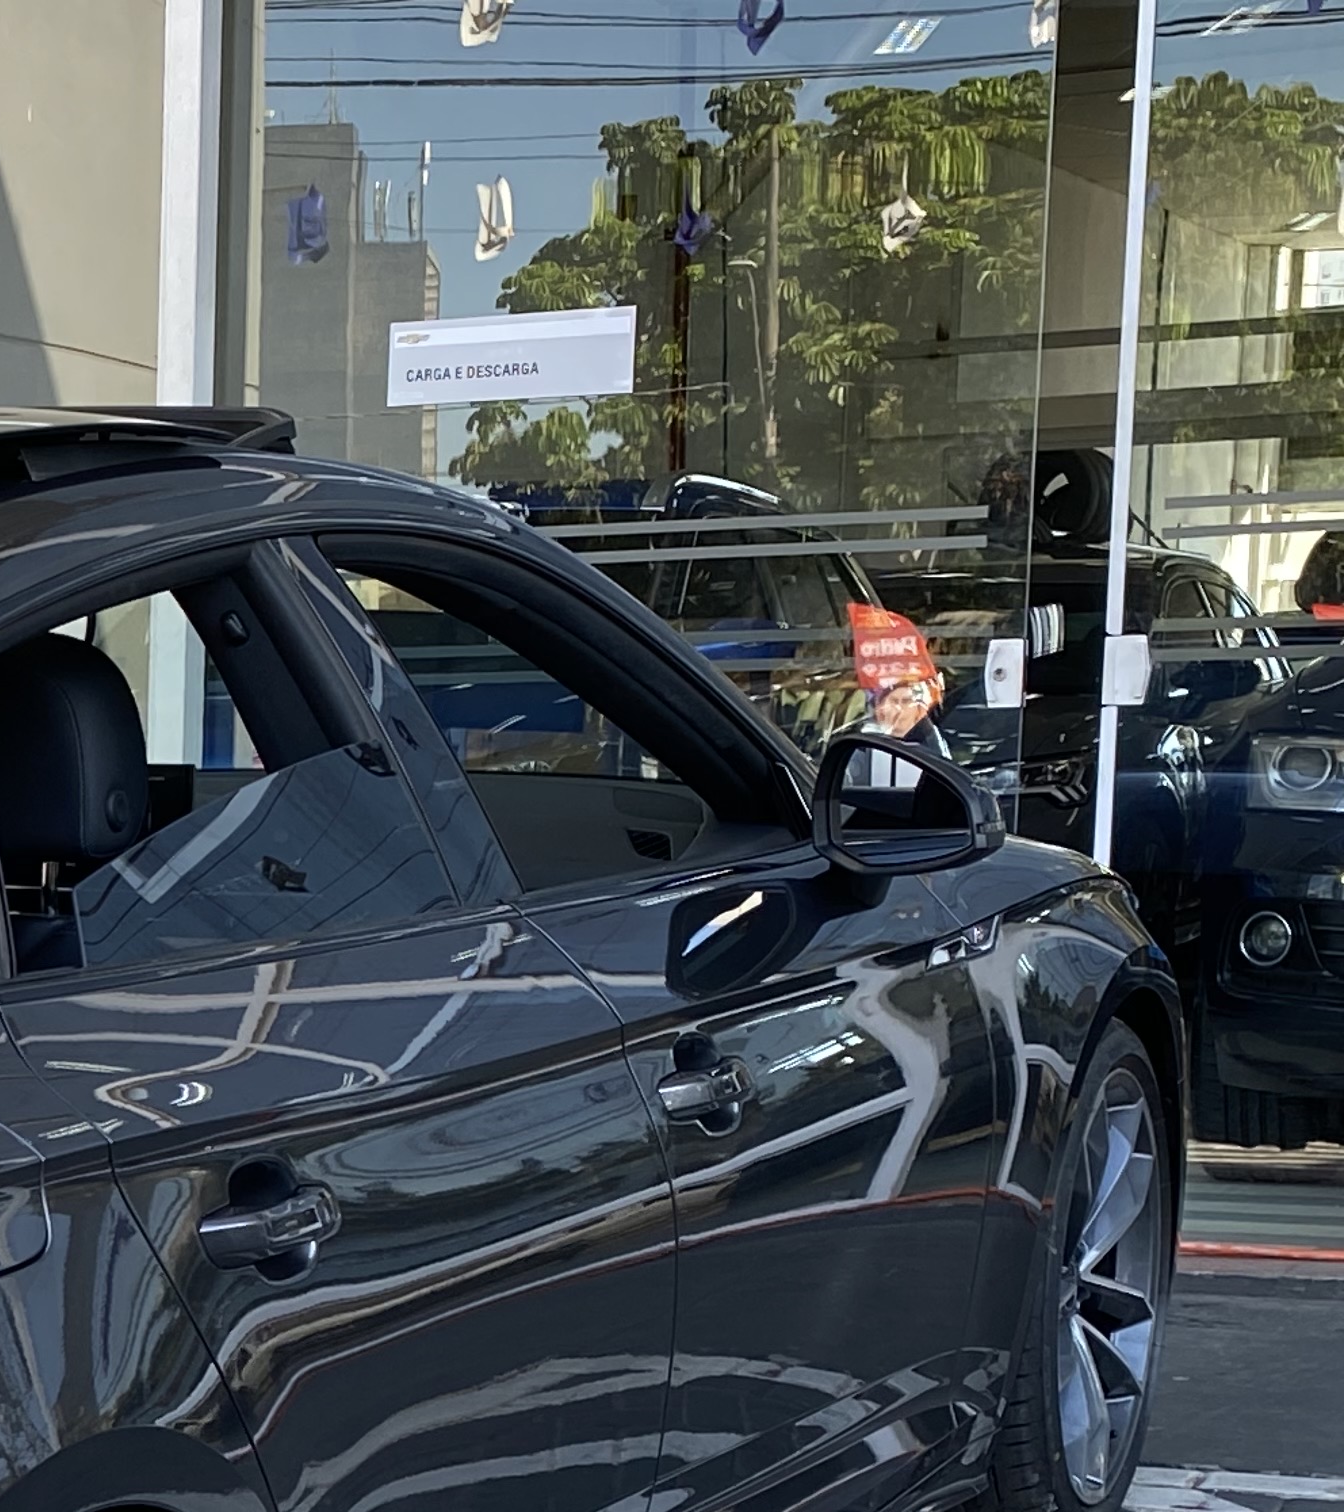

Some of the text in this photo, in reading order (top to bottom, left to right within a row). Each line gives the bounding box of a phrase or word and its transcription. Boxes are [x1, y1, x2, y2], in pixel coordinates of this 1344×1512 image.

[406, 362, 540, 382] CARGA E DESCARGA
